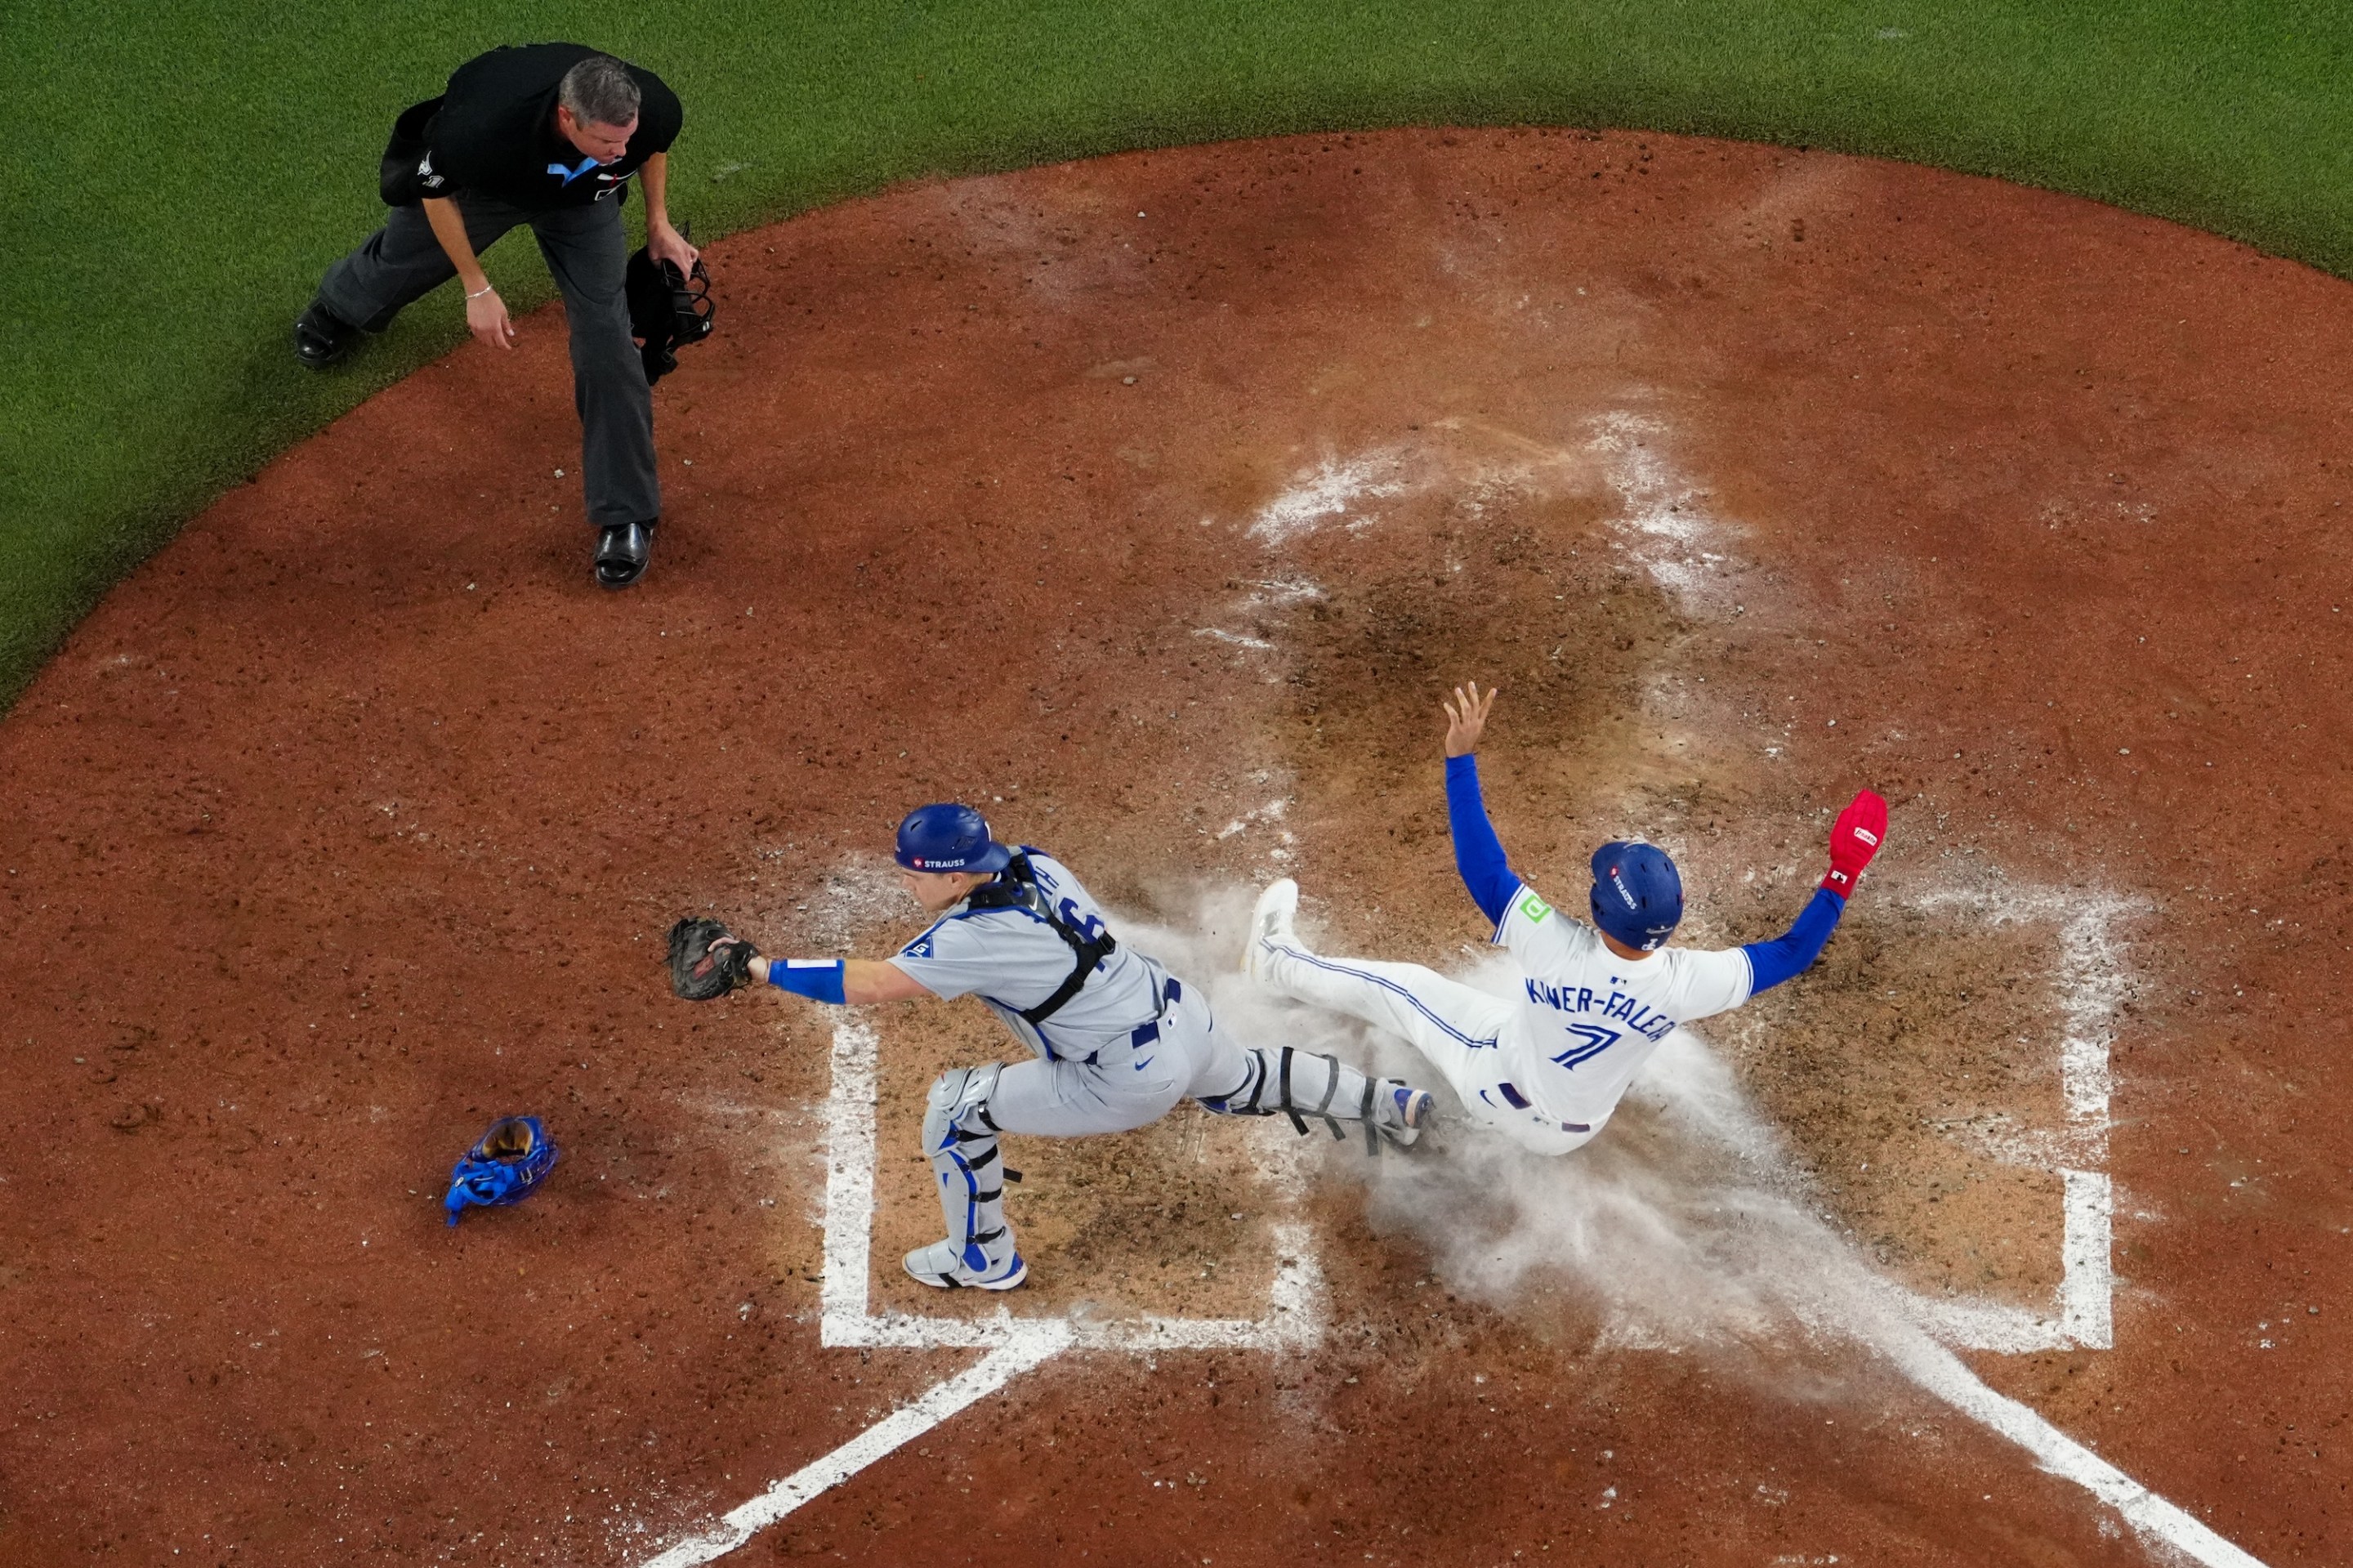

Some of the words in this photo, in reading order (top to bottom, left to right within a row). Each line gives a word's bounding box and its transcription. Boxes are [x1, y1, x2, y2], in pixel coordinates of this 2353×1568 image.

[924, 859, 965, 868] STRAUSS
[1613, 875, 1637, 909] STRAUSS
[1058, 897, 1105, 973] 6
[1548, 1023, 1623, 1072] 7
